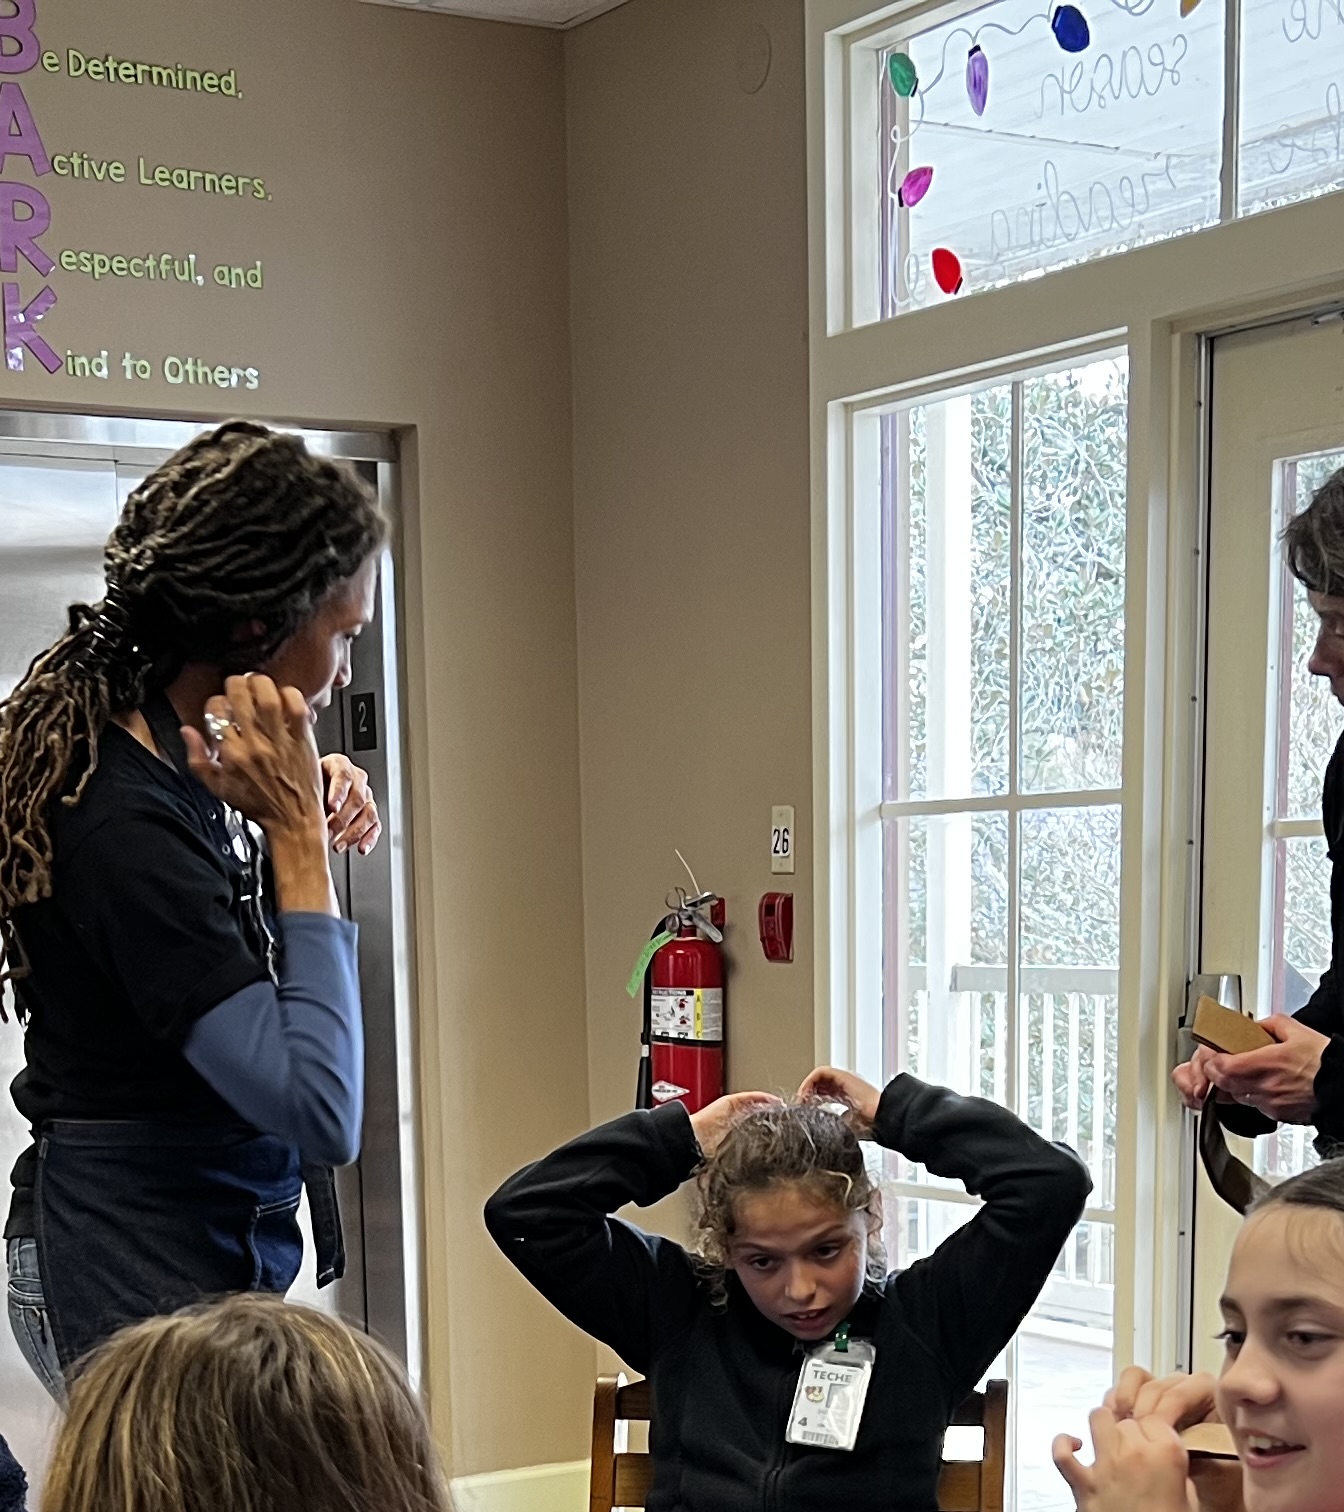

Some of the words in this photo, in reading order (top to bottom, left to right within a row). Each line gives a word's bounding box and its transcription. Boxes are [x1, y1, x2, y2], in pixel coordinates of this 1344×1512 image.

[214, 261, 262, 288] and
[122, 351, 151, 380] to
[164, 357, 259, 390] Others
[358, 701, 368, 733] 2
[773, 828, 789, 854] 26
[813, 1369, 853, 1383] TECHE
[798, 1417, 807, 1427] 4
